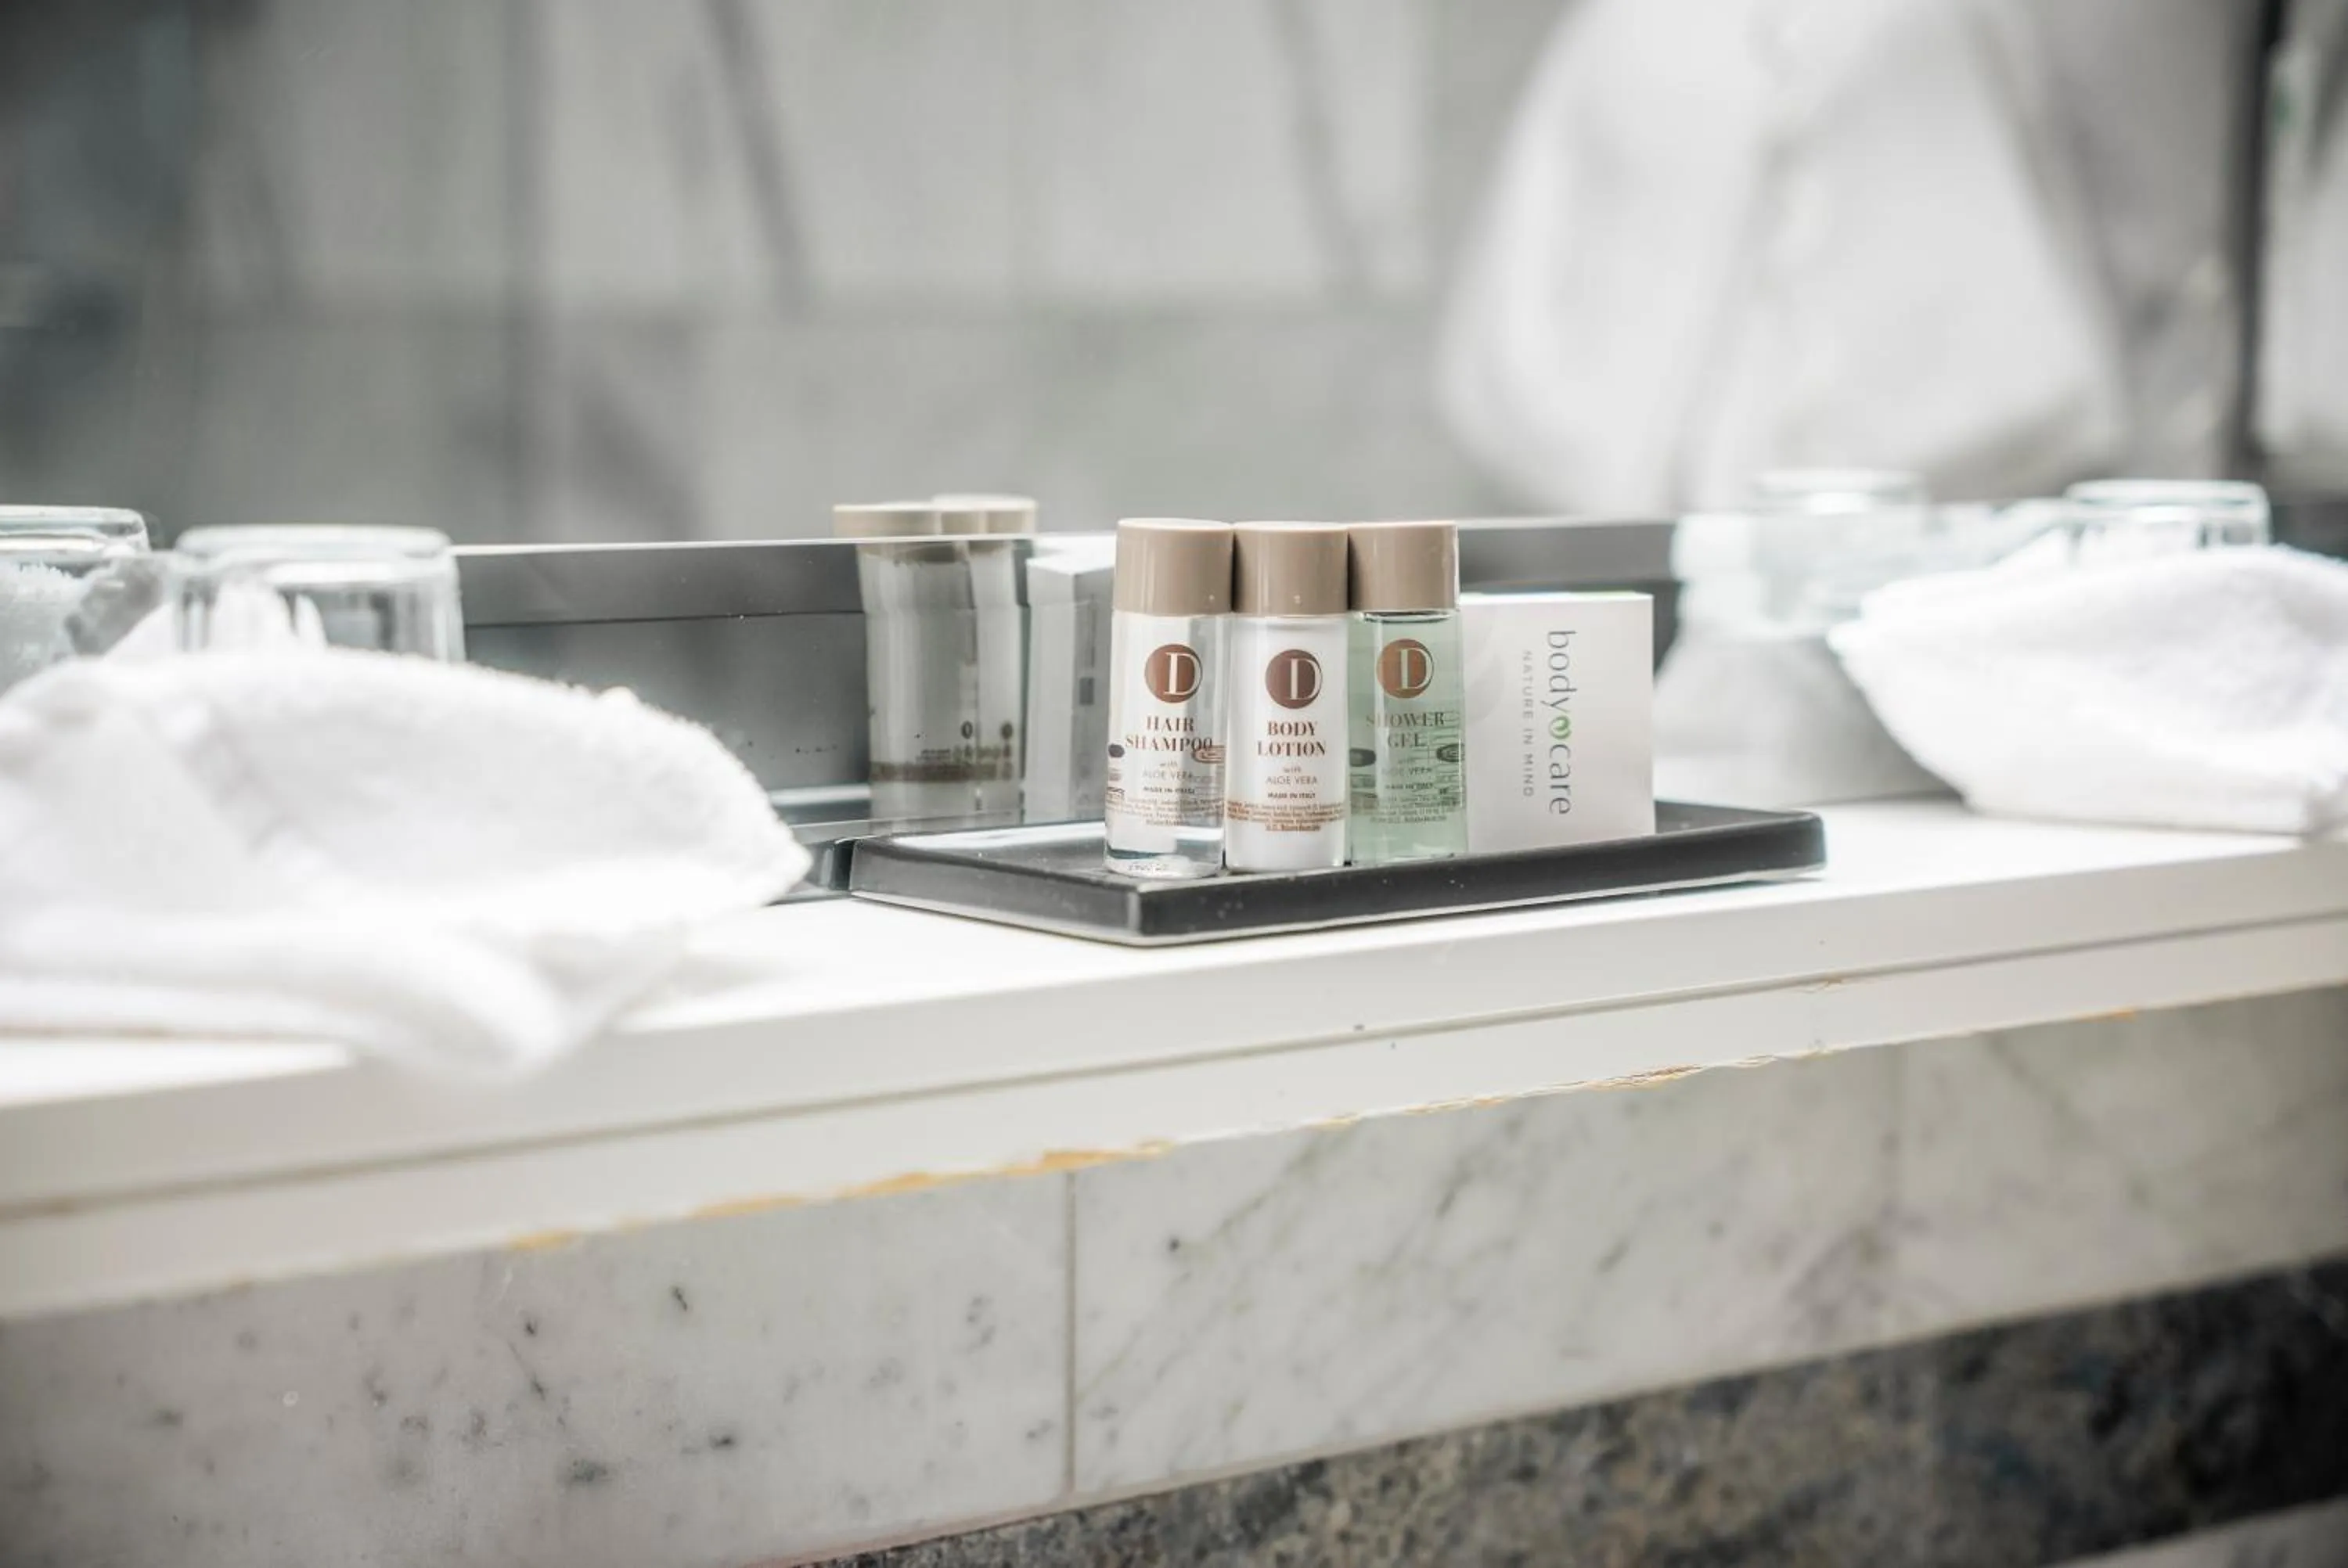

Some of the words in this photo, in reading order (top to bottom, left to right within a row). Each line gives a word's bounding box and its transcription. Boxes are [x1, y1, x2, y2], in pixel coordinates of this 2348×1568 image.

[1540, 629, 1578, 714] body
[1522, 650, 1535, 721] NATURE
[1146, 715, 1195, 732] HAIR
[1266, 720, 1318, 737] BODY
[1366, 713, 1446, 728] SHOWER
[1125, 733, 1214, 752] SHAMPOO
[1388, 732, 1425, 748] GEL
[1522, 728, 1534, 745] IN
[1256, 740, 1327, 757] LOTION
[1265, 775, 1291, 786] ALOE
[1295, 775, 1318, 786] VERA
[1522, 753, 1535, 798] MIND
[1547, 743, 1572, 815] care
